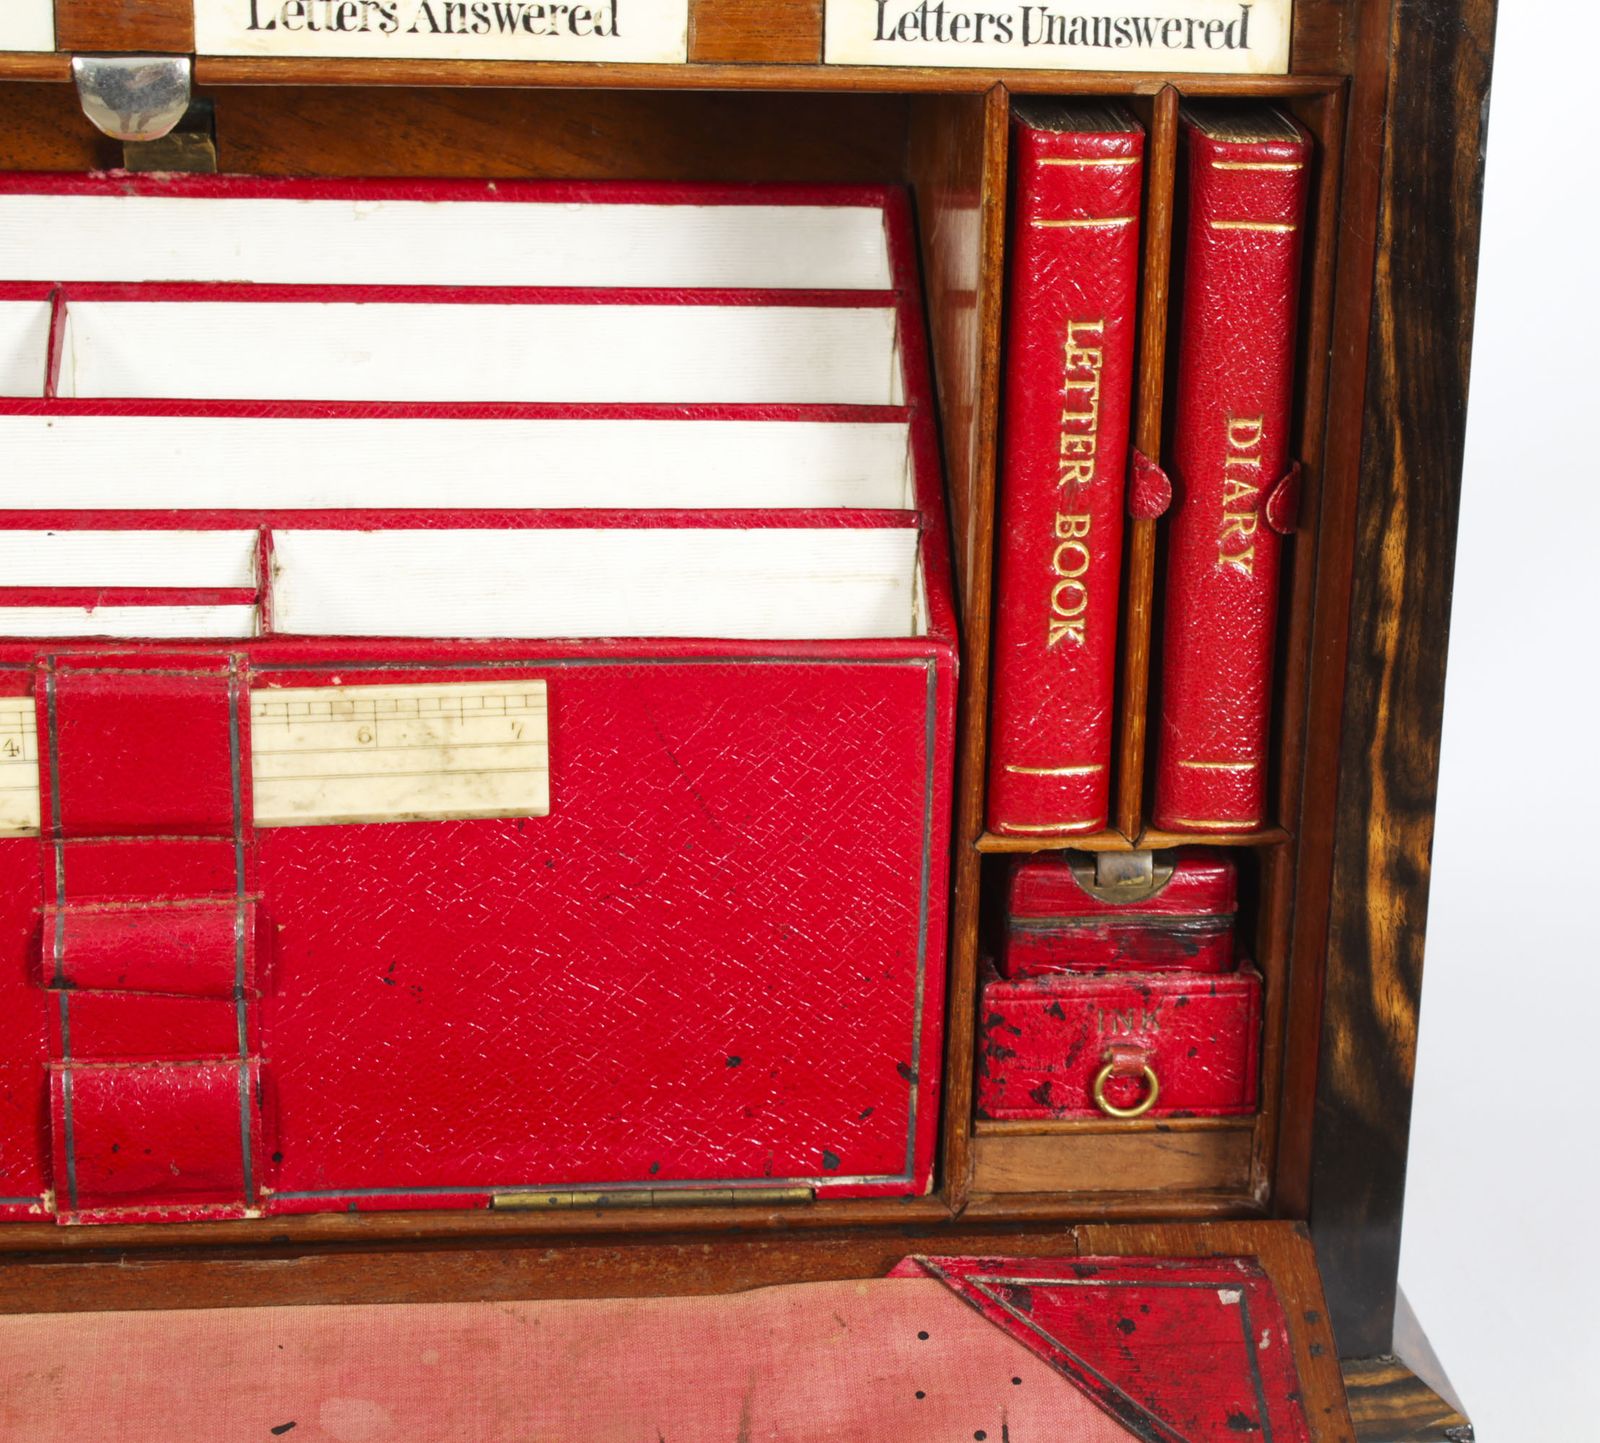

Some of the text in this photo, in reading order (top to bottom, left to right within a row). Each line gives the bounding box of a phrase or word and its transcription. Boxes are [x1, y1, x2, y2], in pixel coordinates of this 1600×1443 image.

[246, 0, 621, 37] Letters Answered
[873, 0, 1252, 50] Letters Unanswered
[1048, 320, 1105, 647] LETTER BOOK
[1218, 415, 1264, 578] DIARY
[2, 737, 20, 758] 4
[357, 724, 373, 744] 6
[1096, 1007, 1163, 1036] INK
